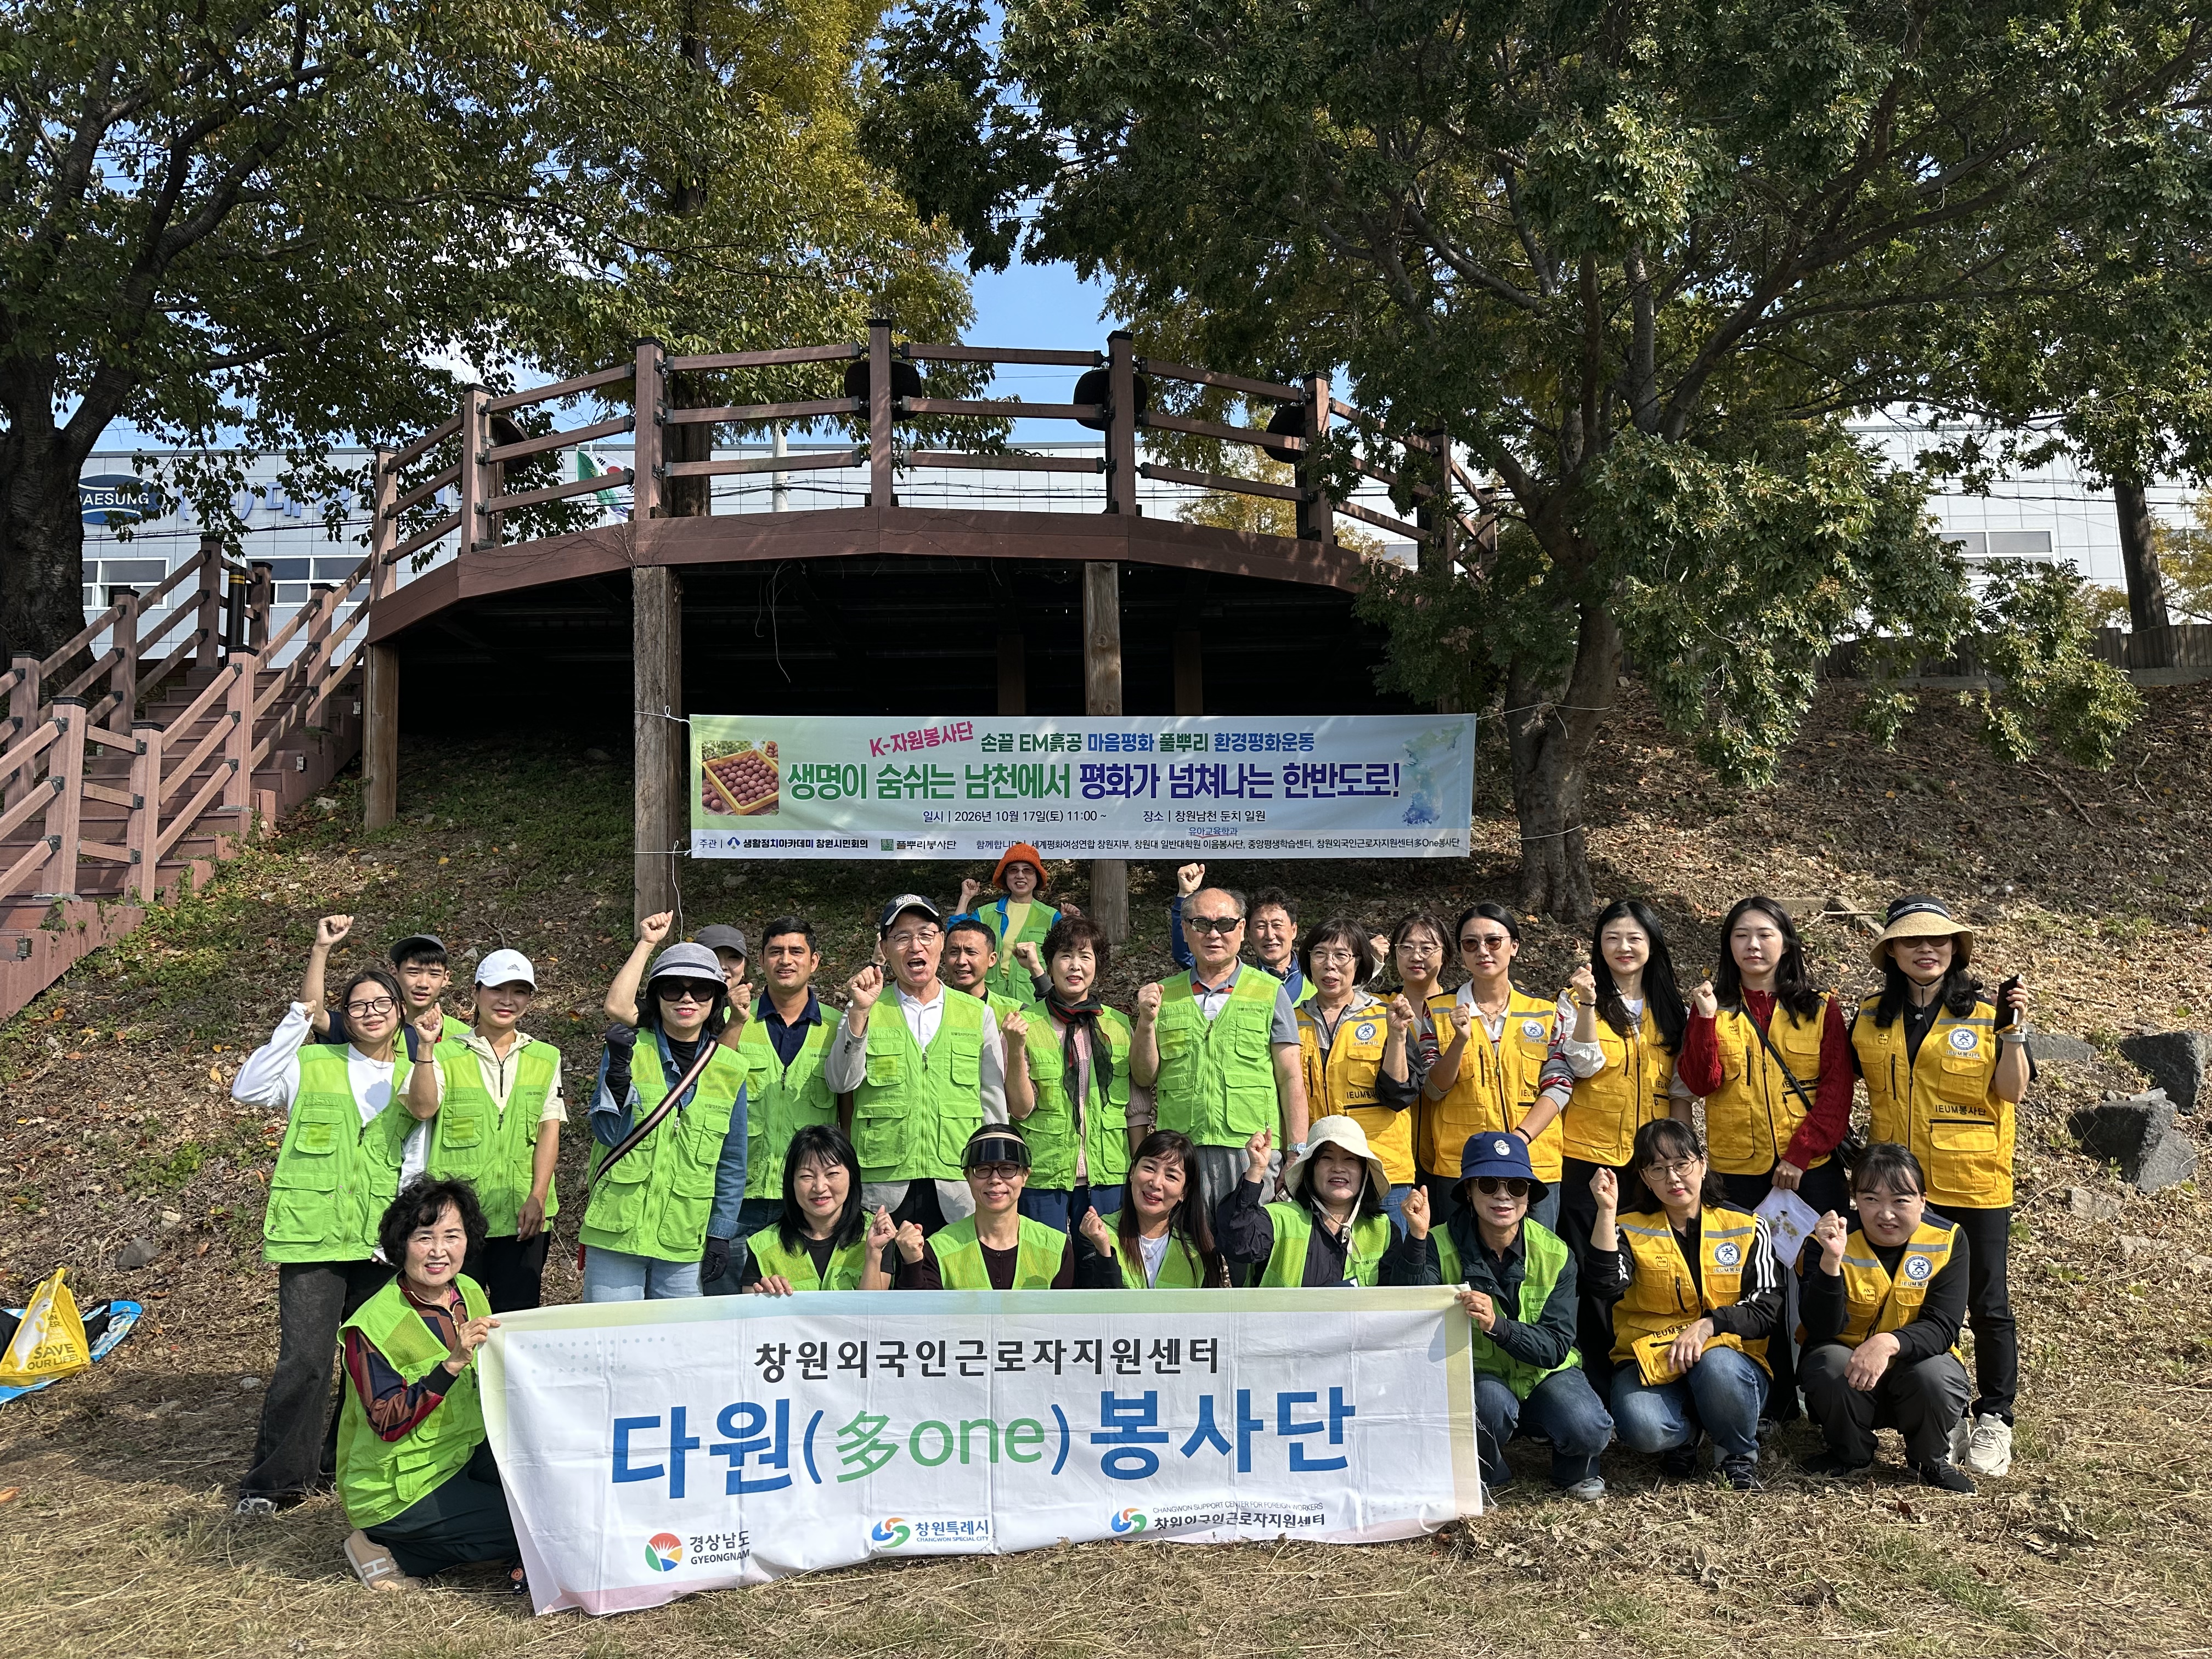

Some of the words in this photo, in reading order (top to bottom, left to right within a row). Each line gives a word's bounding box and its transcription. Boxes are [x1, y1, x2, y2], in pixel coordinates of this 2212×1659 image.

[80, 492, 149, 506] AESUNG
[870, 721, 974, 757] K-자원봉사단
[981, 733, 1014, 752] 손끝
[1019, 733, 1082, 752] EM흙공
[1088, 733, 1154, 753] 마음평화
[1159, 733, 1209, 752] 풀뿌리
[1214, 732, 1314, 752] 환경평화운동
[787, 763, 867, 800] 생명이
[877, 763, 956, 799] 숨쉬는
[966, 763, 1070, 799] 남천에서
[1080, 763, 1160, 799] 평화가
[1169, 763, 1274, 799] 넘쳐나는
[1283, 762, 1400, 798] 한반도로!
[923, 811, 944, 822] 일시
[955, 811, 992, 822] 2026년
[996, 811, 1019, 822] 10월
[1023, 810, 1064, 822] 17일(토)
[1067, 810, 1097, 821] 11:00
[1143, 810, 1164, 822] 장소
[1175, 810, 1217, 822] 창원남천
[1220, 810, 1241, 822] 둔치
[1244, 810, 1266, 822] 일원
[1188, 827, 1238, 837] 유아교육학과
[699, 839, 716, 849] 주관
[743, 839, 814, 849] 생활정치아카데미
[816, 839, 868, 849] 창원시민회의
[896, 840, 957, 850] 풀뿌리봉사단
[1031, 840, 1095, 850] 세계평화여성연합
[1097, 840, 1132, 850] 창원지부,
[1135, 840, 1158, 849] 창원대
[1161, 840, 1201, 849] 일반대학원
[1203, 839, 1245, 850] 이음봉사단,
[1248, 839, 1314, 849] 중앙평생학습센터,
[1935, 1104, 1986, 1116] IEUM봉사단
[33, 1344, 75, 1359] SAVE
[27, 1359, 52, 1370] OUR
[755, 1338, 1219, 1384] 창원외국인근로자지원센터
[1091, 1386, 1356, 1480] 봉사단
[1153, 1505, 1192, 1513] CHANGWON
[1194, 1502, 1223, 1510] SUPPORT
[1293, 1503, 1323, 1511] WORKERS
[915, 1520, 988, 1537] 창원특례시
[690, 1531, 749, 1553] 경상남도
[691, 1549, 749, 1565] GYEONGNAM
